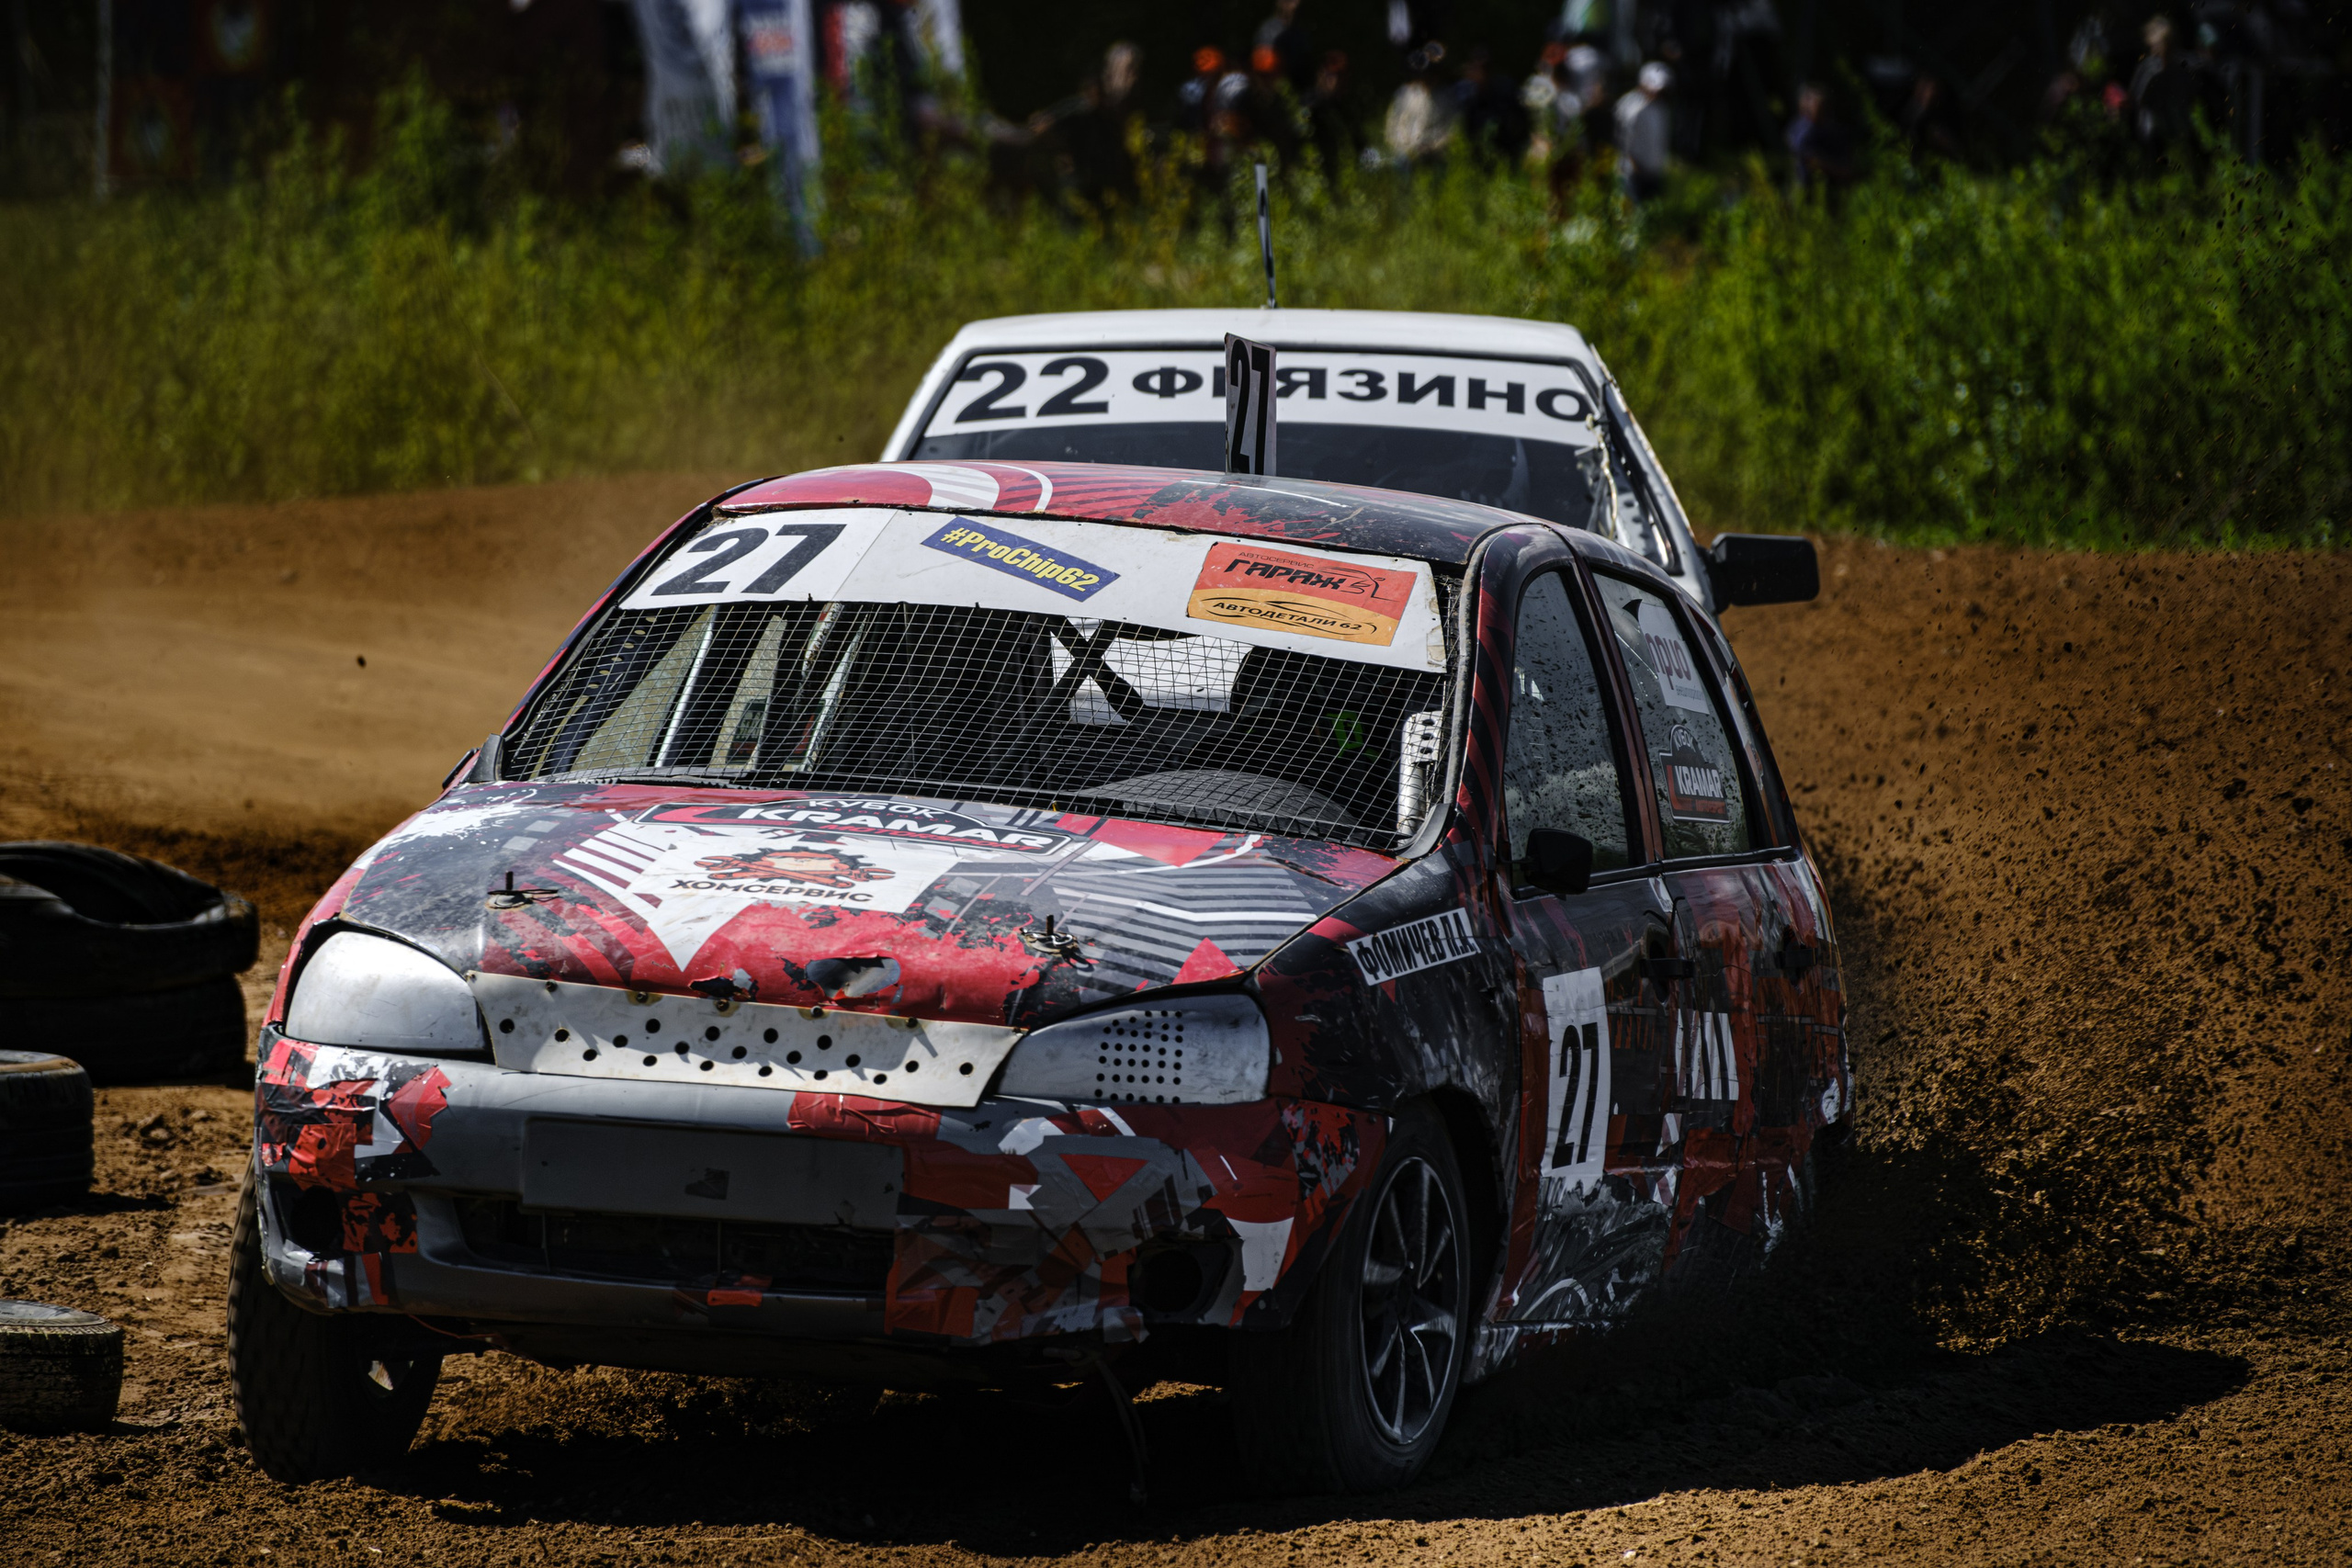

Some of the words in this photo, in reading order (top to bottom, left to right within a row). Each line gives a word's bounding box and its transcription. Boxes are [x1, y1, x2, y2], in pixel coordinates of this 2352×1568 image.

[955, 356, 1110, 423] 22
[1230, 339, 1270, 475] 27
[650, 524, 848, 596] 27
[940, 525, 1101, 592] #ProChip62
[1224, 558, 1347, 591] ГАРАЖ
[1238, 551, 1315, 570] АВТОСЕРВИС
[1213, 602, 1336, 626] АВТОДЕТАЛИ
[1340, 620, 1363, 631] 62
[1674, 765, 1724, 798] KRAMAR
[738, 807, 1053, 848] KRAMAR
[808, 800, 945, 818] КУБОК
[818, 824, 1042, 852] MOTORSPORT
[669, 878, 874, 904] ХОМСЕРВИС
[1356, 919, 1447, 981] ФОМИЧЕВ
[1552, 1021, 1599, 1169] 27
